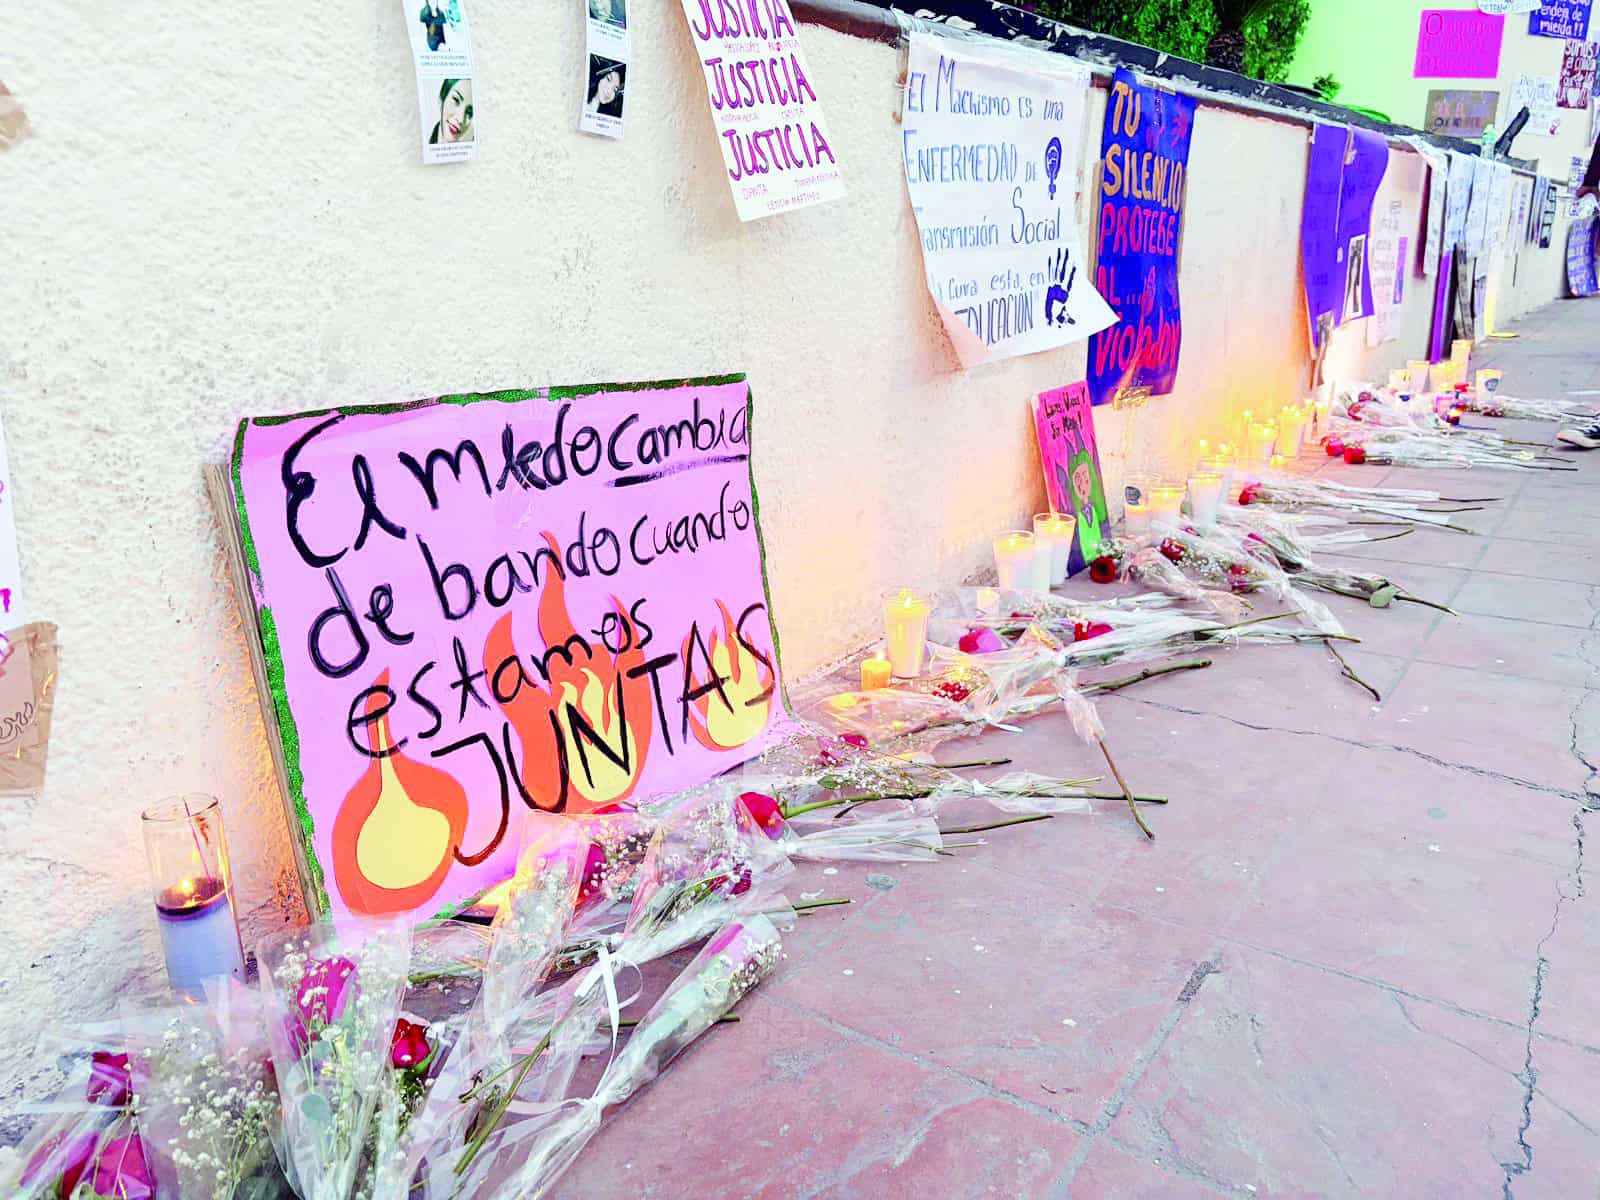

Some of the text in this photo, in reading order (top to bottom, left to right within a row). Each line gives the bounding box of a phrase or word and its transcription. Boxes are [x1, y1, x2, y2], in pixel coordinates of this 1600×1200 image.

[705, 52, 817, 110] JUSTICIA
[908, 71, 926, 113] El
[935, 54, 1010, 117] Machismo
[1043, 98, 1064, 121] una
[1110, 80, 1141, 139] TU
[722, 121, 835, 181] JUSTICIA
[904, 129, 1017, 184] ENFERMEDAD
[1103, 143, 1183, 214] SILENCIO
[1011, 186, 1061, 245] Social
[1030, 271, 1045, 287] en
[281, 415, 407, 569] El
[308, 567, 415, 678] de
[416, 511, 621, 621] bando
[347, 597, 654, 759] estamos
[430, 603, 776, 867] JUNTAS
